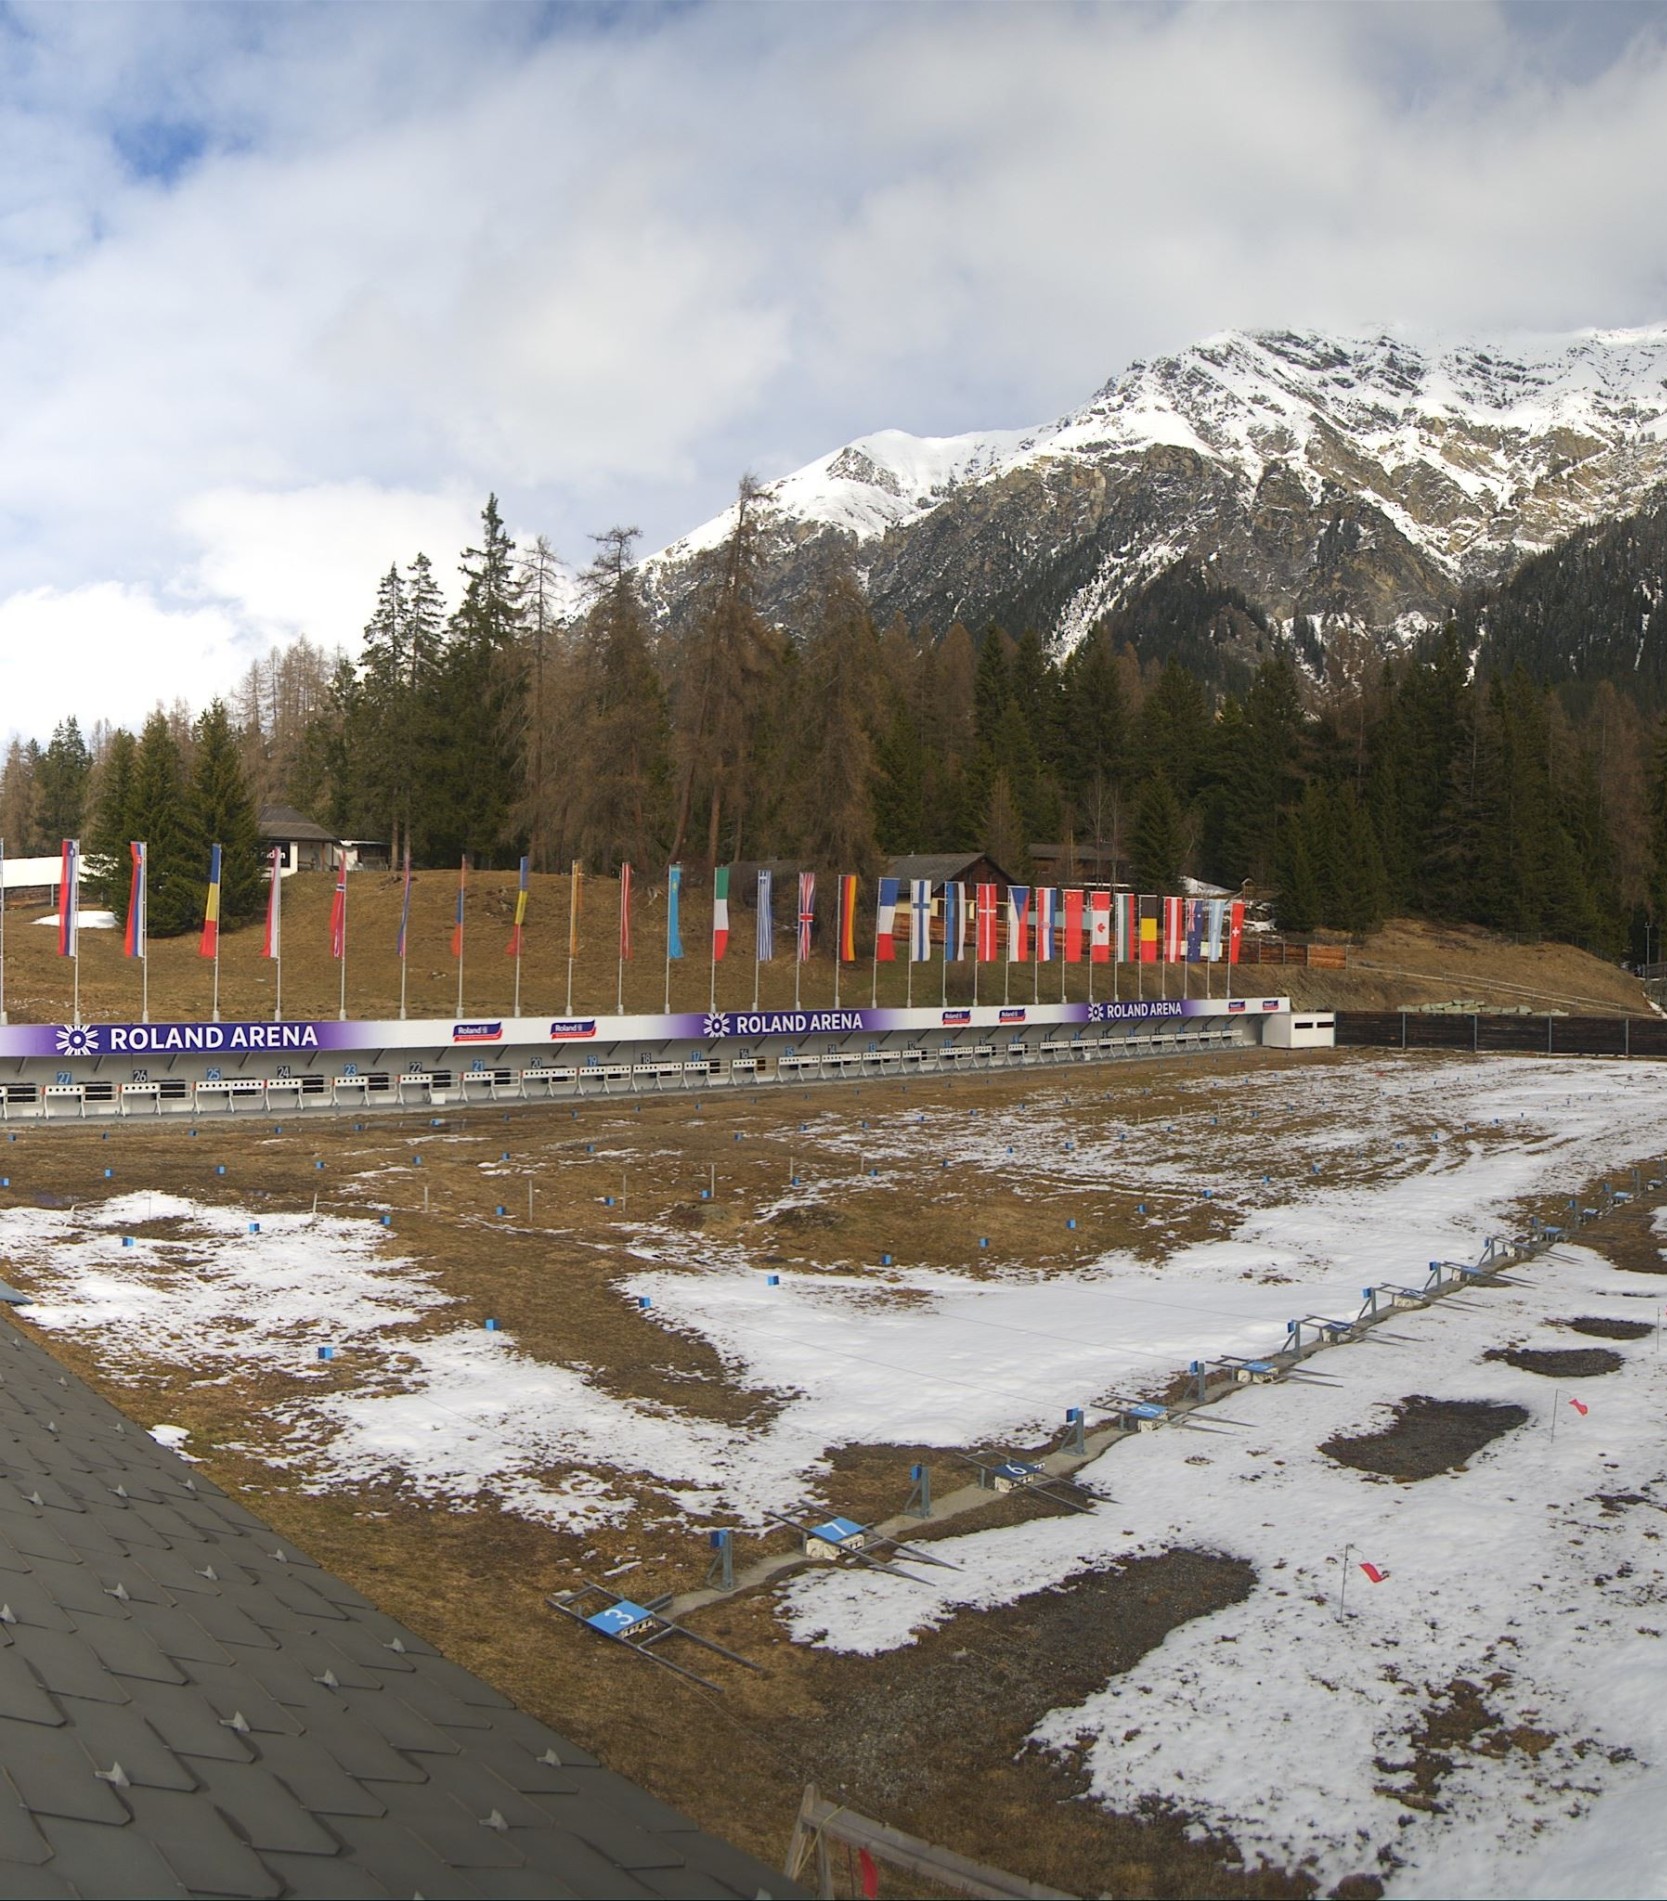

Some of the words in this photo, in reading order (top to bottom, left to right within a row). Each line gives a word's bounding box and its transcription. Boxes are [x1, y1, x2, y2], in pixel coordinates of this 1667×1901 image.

[1107, 1003, 1149, 1018] ROLAND
[1150, 1003, 1182, 1016] ARENA
[736, 1015, 807, 1034] ROLAND
[809, 1013, 863, 1031] ARENA
[111, 1027, 224, 1050] ROLAND
[230, 1026, 319, 1048] ARENA
[473, 1060, 484, 1071] 21
[531, 1057, 542, 1068] 20
[588, 1056, 598, 1066] 19
[278, 1066, 290, 1078] 24
[345, 1064, 357, 1075] 23
[410, 1062, 422, 1073] 22
[58, 1072, 71, 1084] 27
[133, 1070, 147, 1082] 26
[207, 1068, 220, 1080] 25
[822, 1522, 848, 1536] 7
